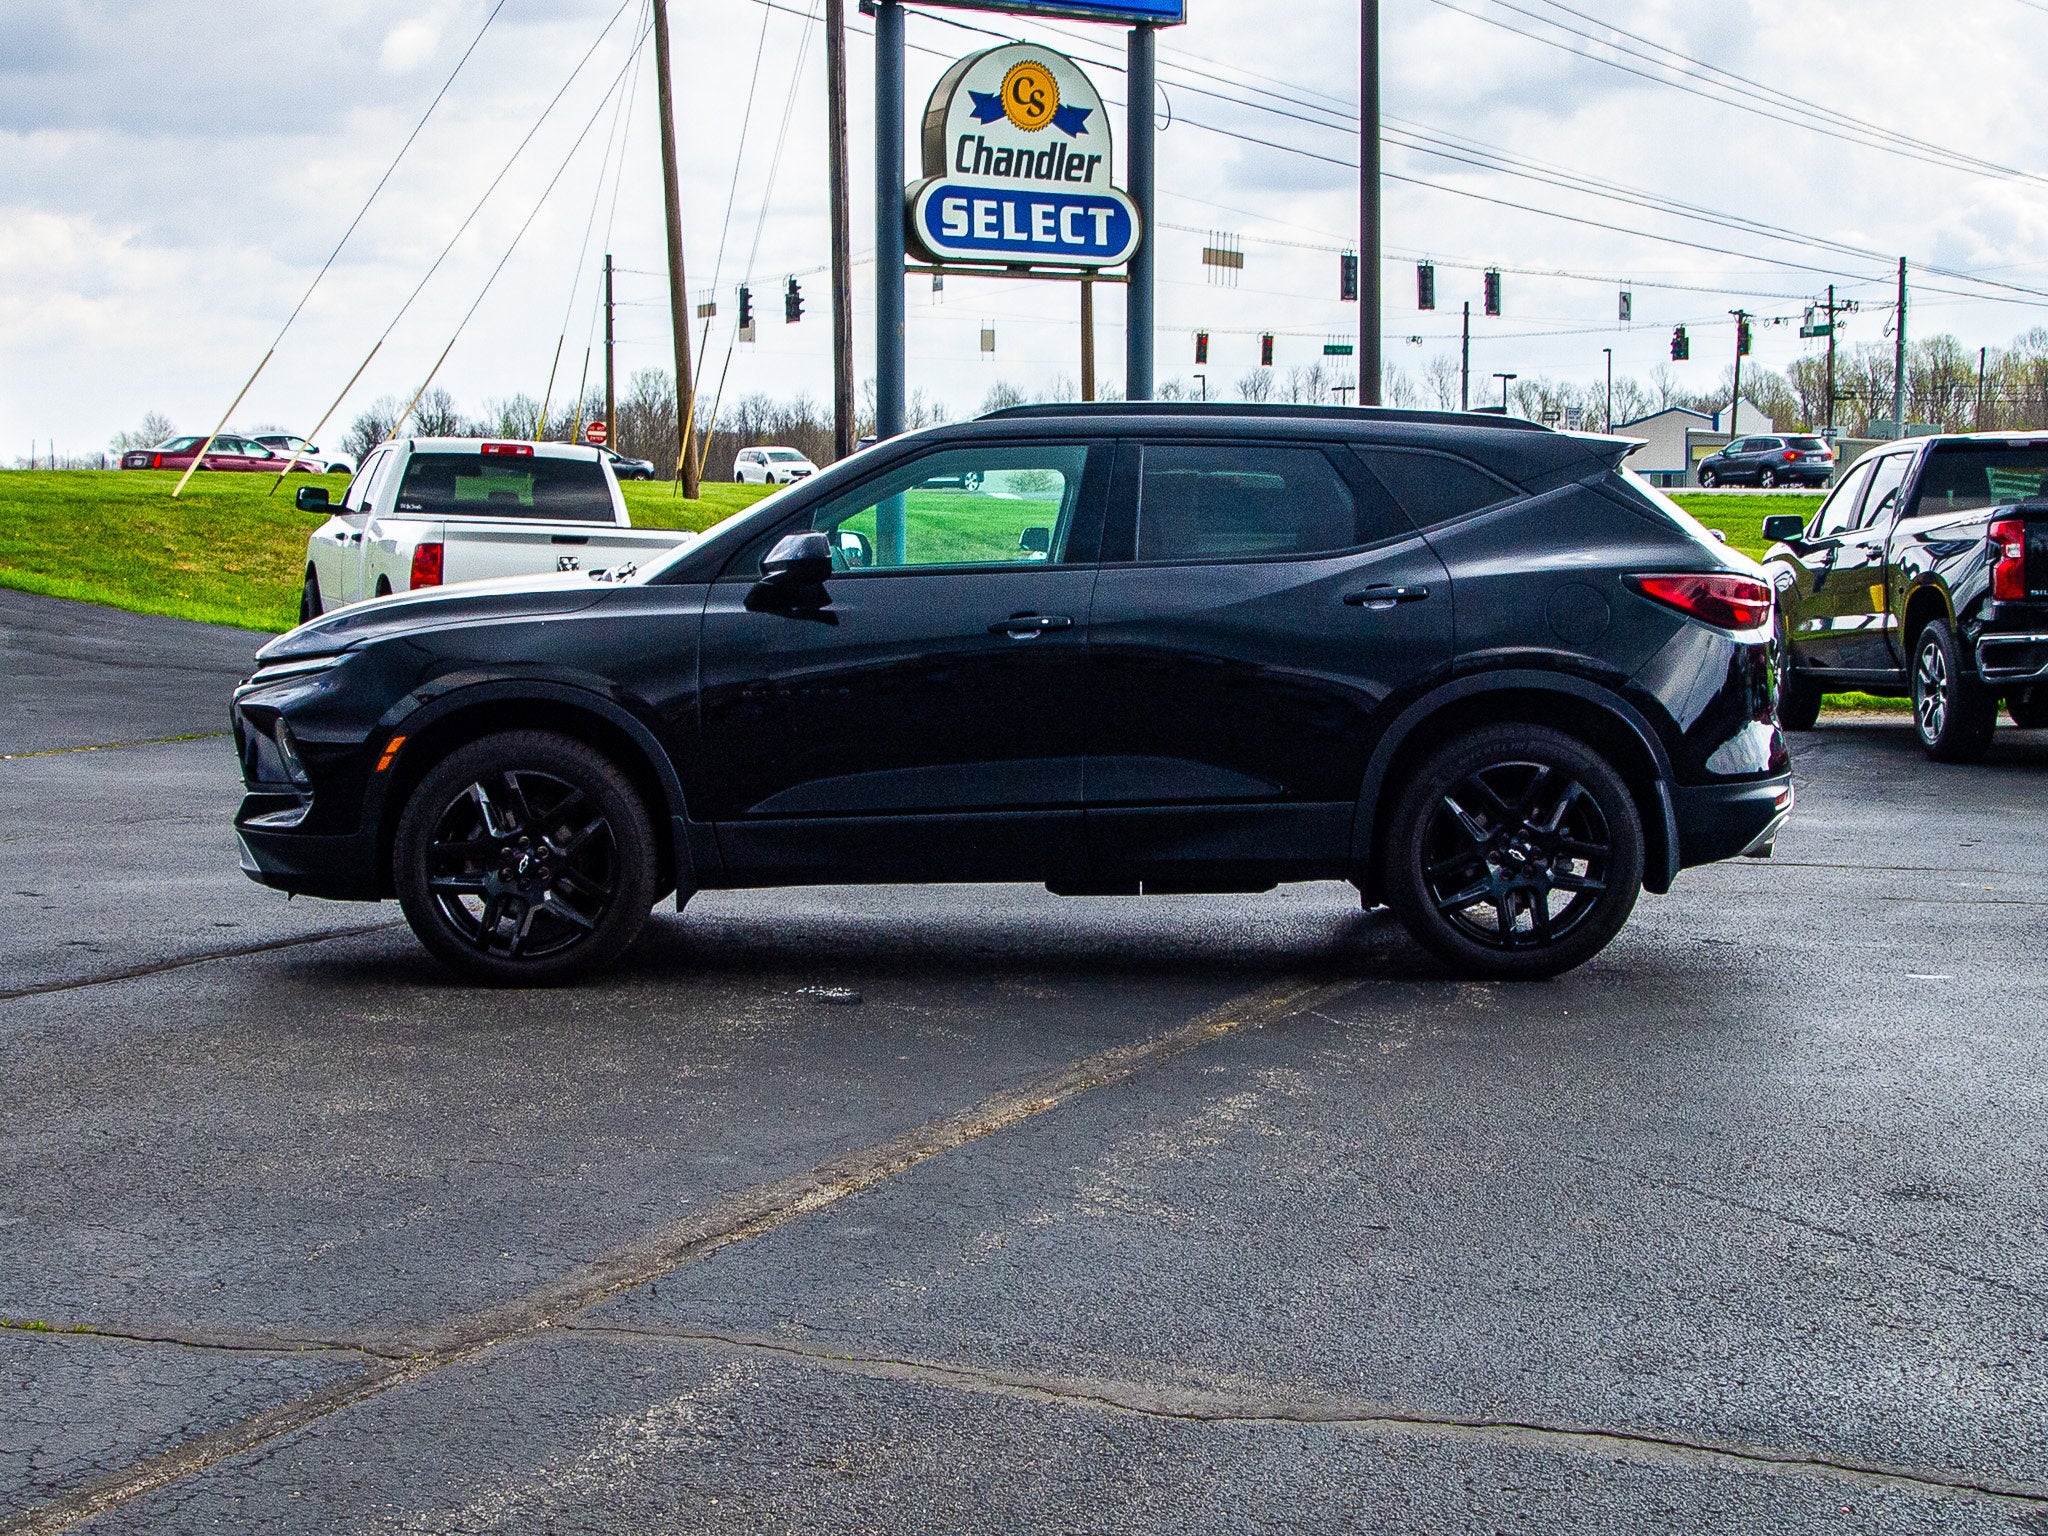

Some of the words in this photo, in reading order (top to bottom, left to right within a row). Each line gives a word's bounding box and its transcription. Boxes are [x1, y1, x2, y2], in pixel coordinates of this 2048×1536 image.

[1012, 76, 1045, 117] CS
[955, 133, 1103, 183] Chandler
[941, 196, 1115, 246] SELECT
